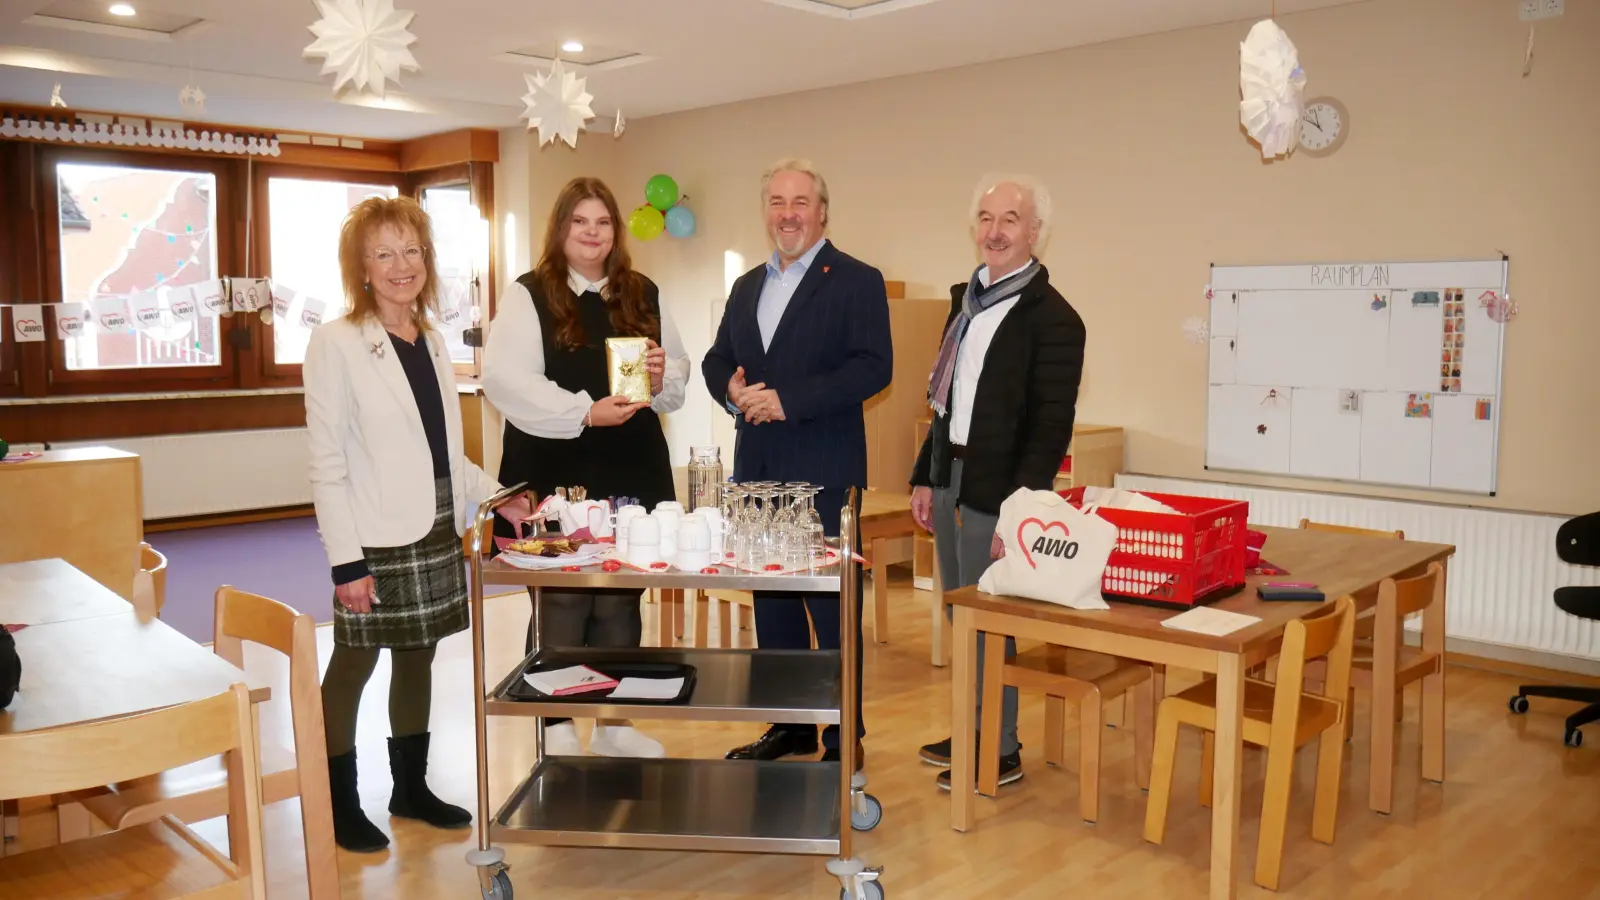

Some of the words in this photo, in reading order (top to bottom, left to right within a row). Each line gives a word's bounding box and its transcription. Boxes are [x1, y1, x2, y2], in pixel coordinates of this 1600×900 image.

[1311, 265, 1389, 287] RAUMPLAN
[23, 324, 42, 333] AWO
[107, 318, 125, 326] AWO
[1031, 535, 1079, 560] AWO
